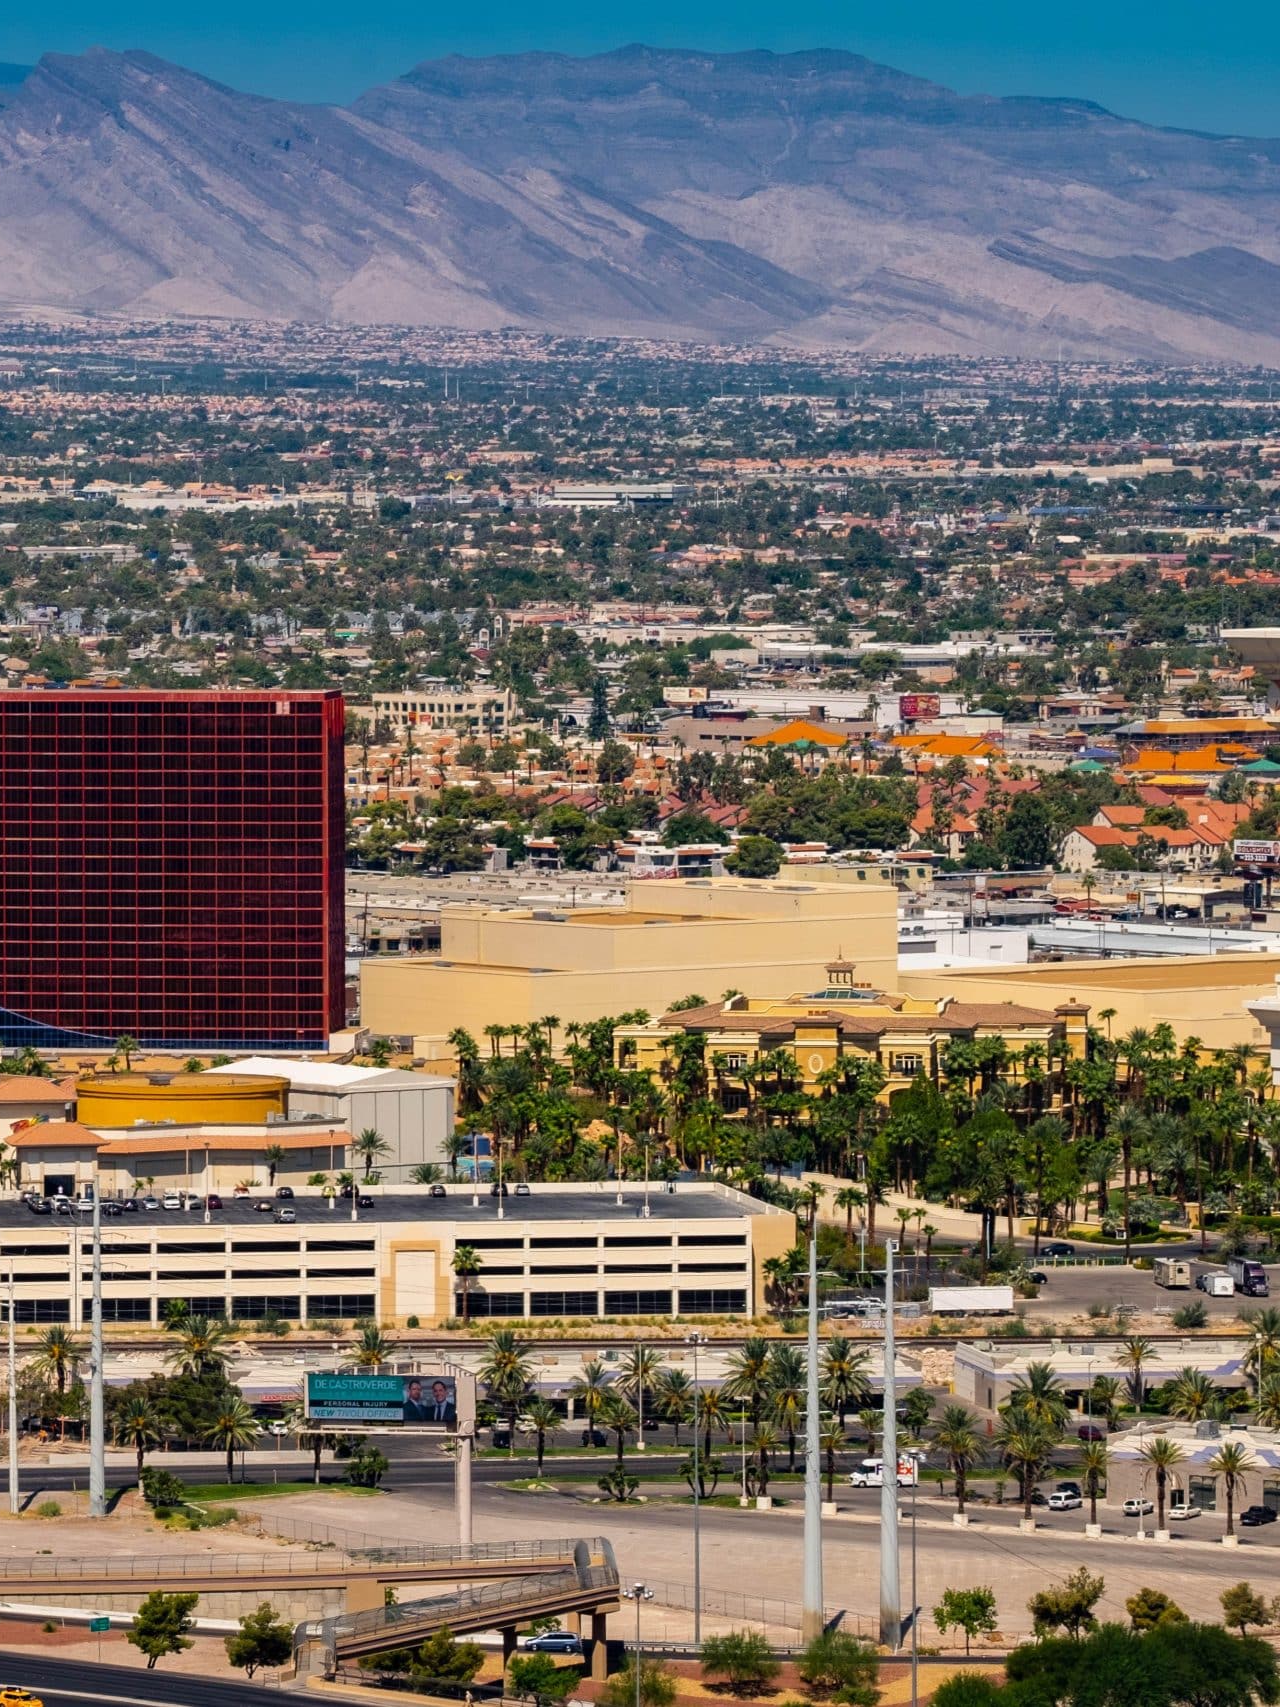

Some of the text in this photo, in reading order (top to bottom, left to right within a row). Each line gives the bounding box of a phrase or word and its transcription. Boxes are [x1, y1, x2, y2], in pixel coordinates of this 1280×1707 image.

[315, 1379, 397, 1390] DE CASTROVERDE
[314, 1409, 334, 1417] NEW
[366, 1410, 400, 1418] OFFICE
[876, 1463, 913, 1475] FEx
